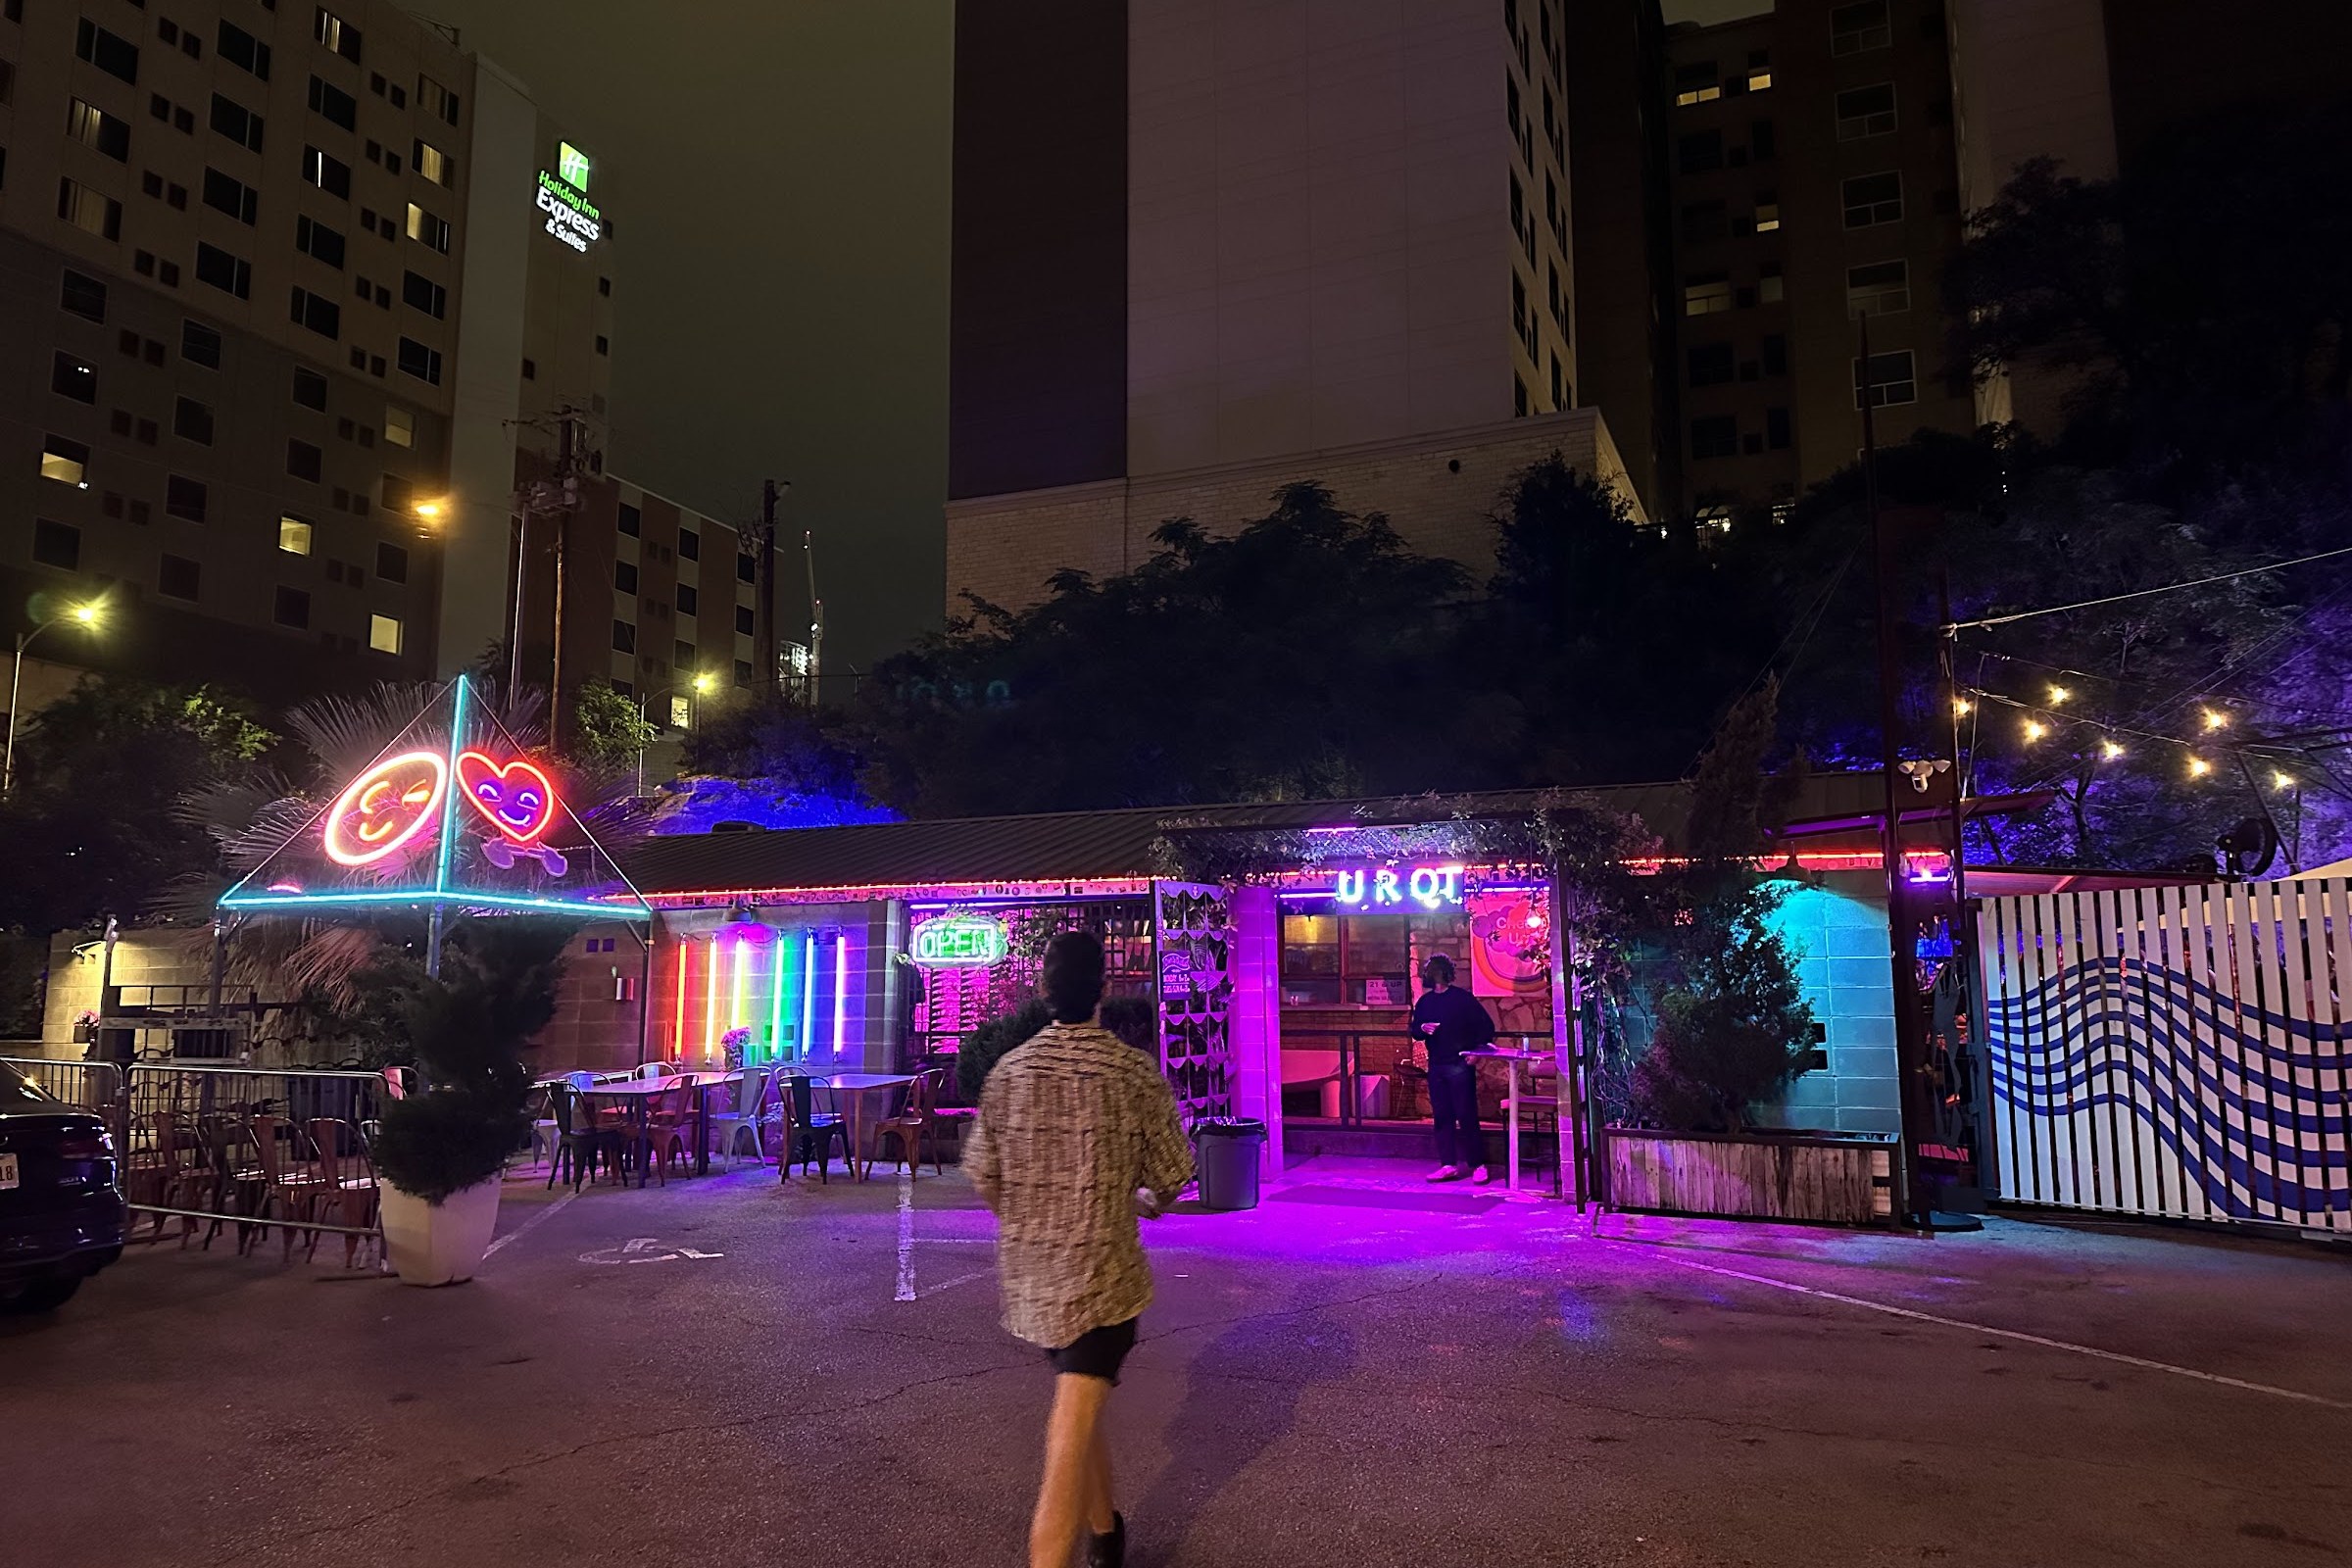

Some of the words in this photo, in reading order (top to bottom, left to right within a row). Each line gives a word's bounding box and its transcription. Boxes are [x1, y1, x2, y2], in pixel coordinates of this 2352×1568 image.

[536, 185, 601, 241] Express
[538, 170, 582, 211] Holiday
[581, 198, 600, 220] Inn
[545, 218, 556, 235] &
[555, 223, 587, 253] Suites
[919, 929, 991, 957] OPEN
